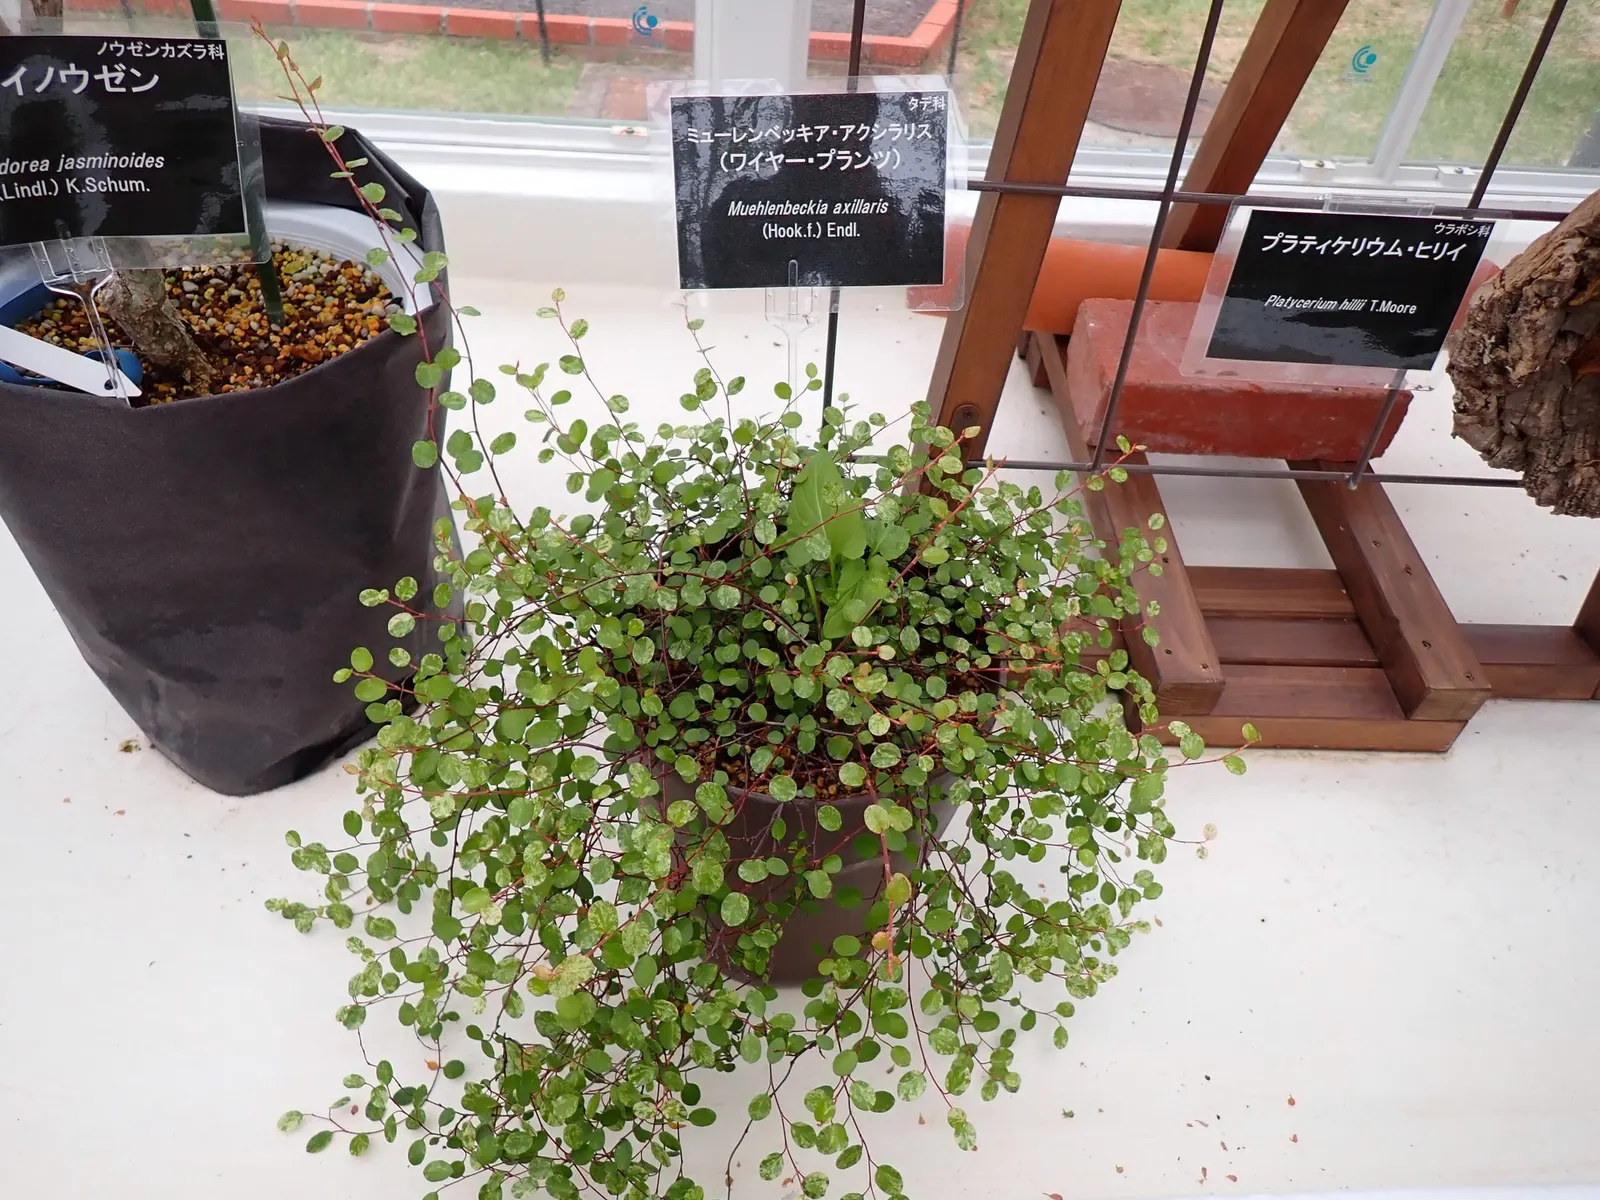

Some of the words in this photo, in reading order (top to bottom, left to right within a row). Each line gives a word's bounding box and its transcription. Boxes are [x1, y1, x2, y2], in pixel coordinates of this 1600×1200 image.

[97, 41, 225, 60] ノウゼンカズラ科
[1, 63, 159, 96] イノウゼン
[908, 95, 946, 111] タデ科
[687, 123, 932, 143] ミューレンベッキア・アクシラリス
[0, 158, 50, 175] dorea
[57, 152, 164, 172] jasminoides
[720, 148, 901, 173] （ワイヤー・プランツ）
[0, 178, 59, 201] Lindl.)
[66, 177, 150, 195] K.Schum.
[727, 199, 829, 217] Muehlenbeckia
[833, 198, 889, 215] axillaris
[762, 221, 822, 240] (Hook.f.)
[827, 222, 861, 238] Endl.
[1434, 222, 1491, 238] ウラボシ科
[1261, 231, 1467, 262] プラティケリウム・ヒリイ
[1264, 294, 1338, 311] Platycerium
[1338, 298, 1368, 311] hillii
[1369, 299, 1417, 314] T.Moore
